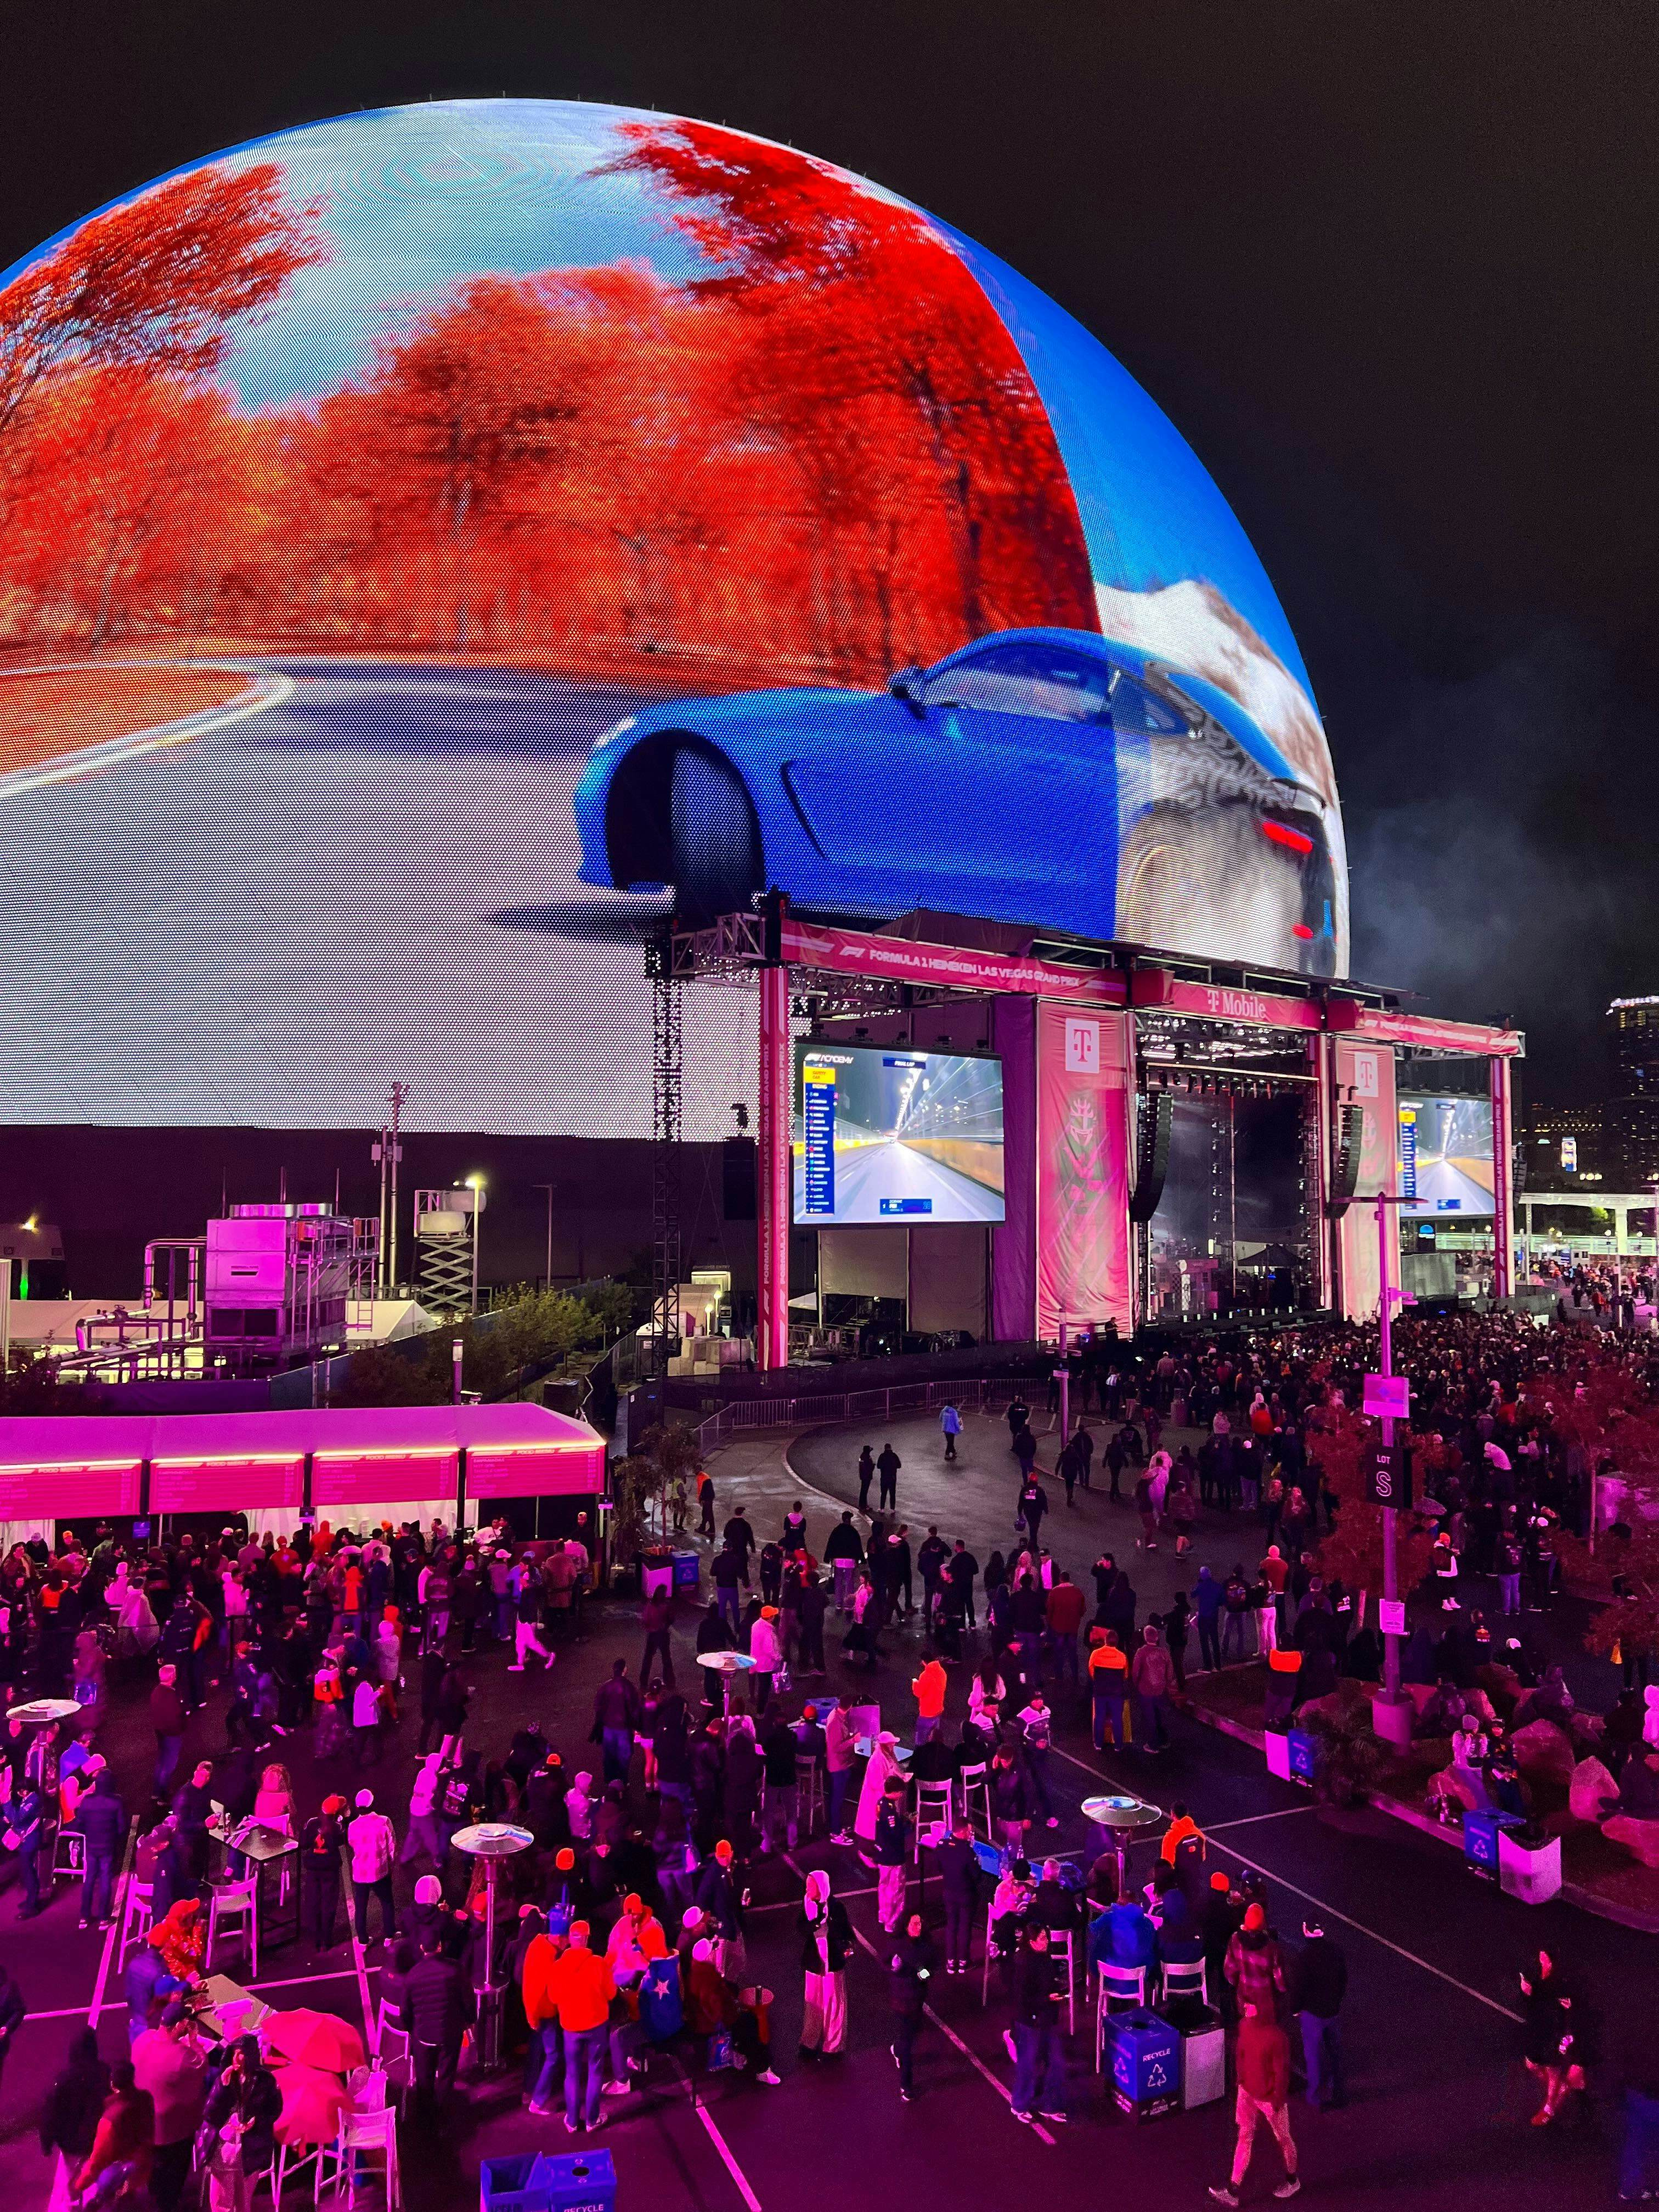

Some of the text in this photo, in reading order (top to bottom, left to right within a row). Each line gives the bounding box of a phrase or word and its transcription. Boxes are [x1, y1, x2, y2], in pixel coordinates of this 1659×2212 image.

[870, 950, 921, 967] FORMULA
[922, 957, 928, 968] 1
[929, 960, 977, 974] HEINEKEN
[978, 965, 998, 977] LAS
[998, 968, 1033, 979] VEGAS
[1034, 970, 1060, 984] GRAND
[1060, 975, 1080, 987] PRIX
[1222, 992, 1266, 1019] Mobile
[1376, 1454, 1391, 1464] LOT
[1376, 1471, 1392, 1497] S
[1143, 2048, 1171, 2062] RECYCLE
